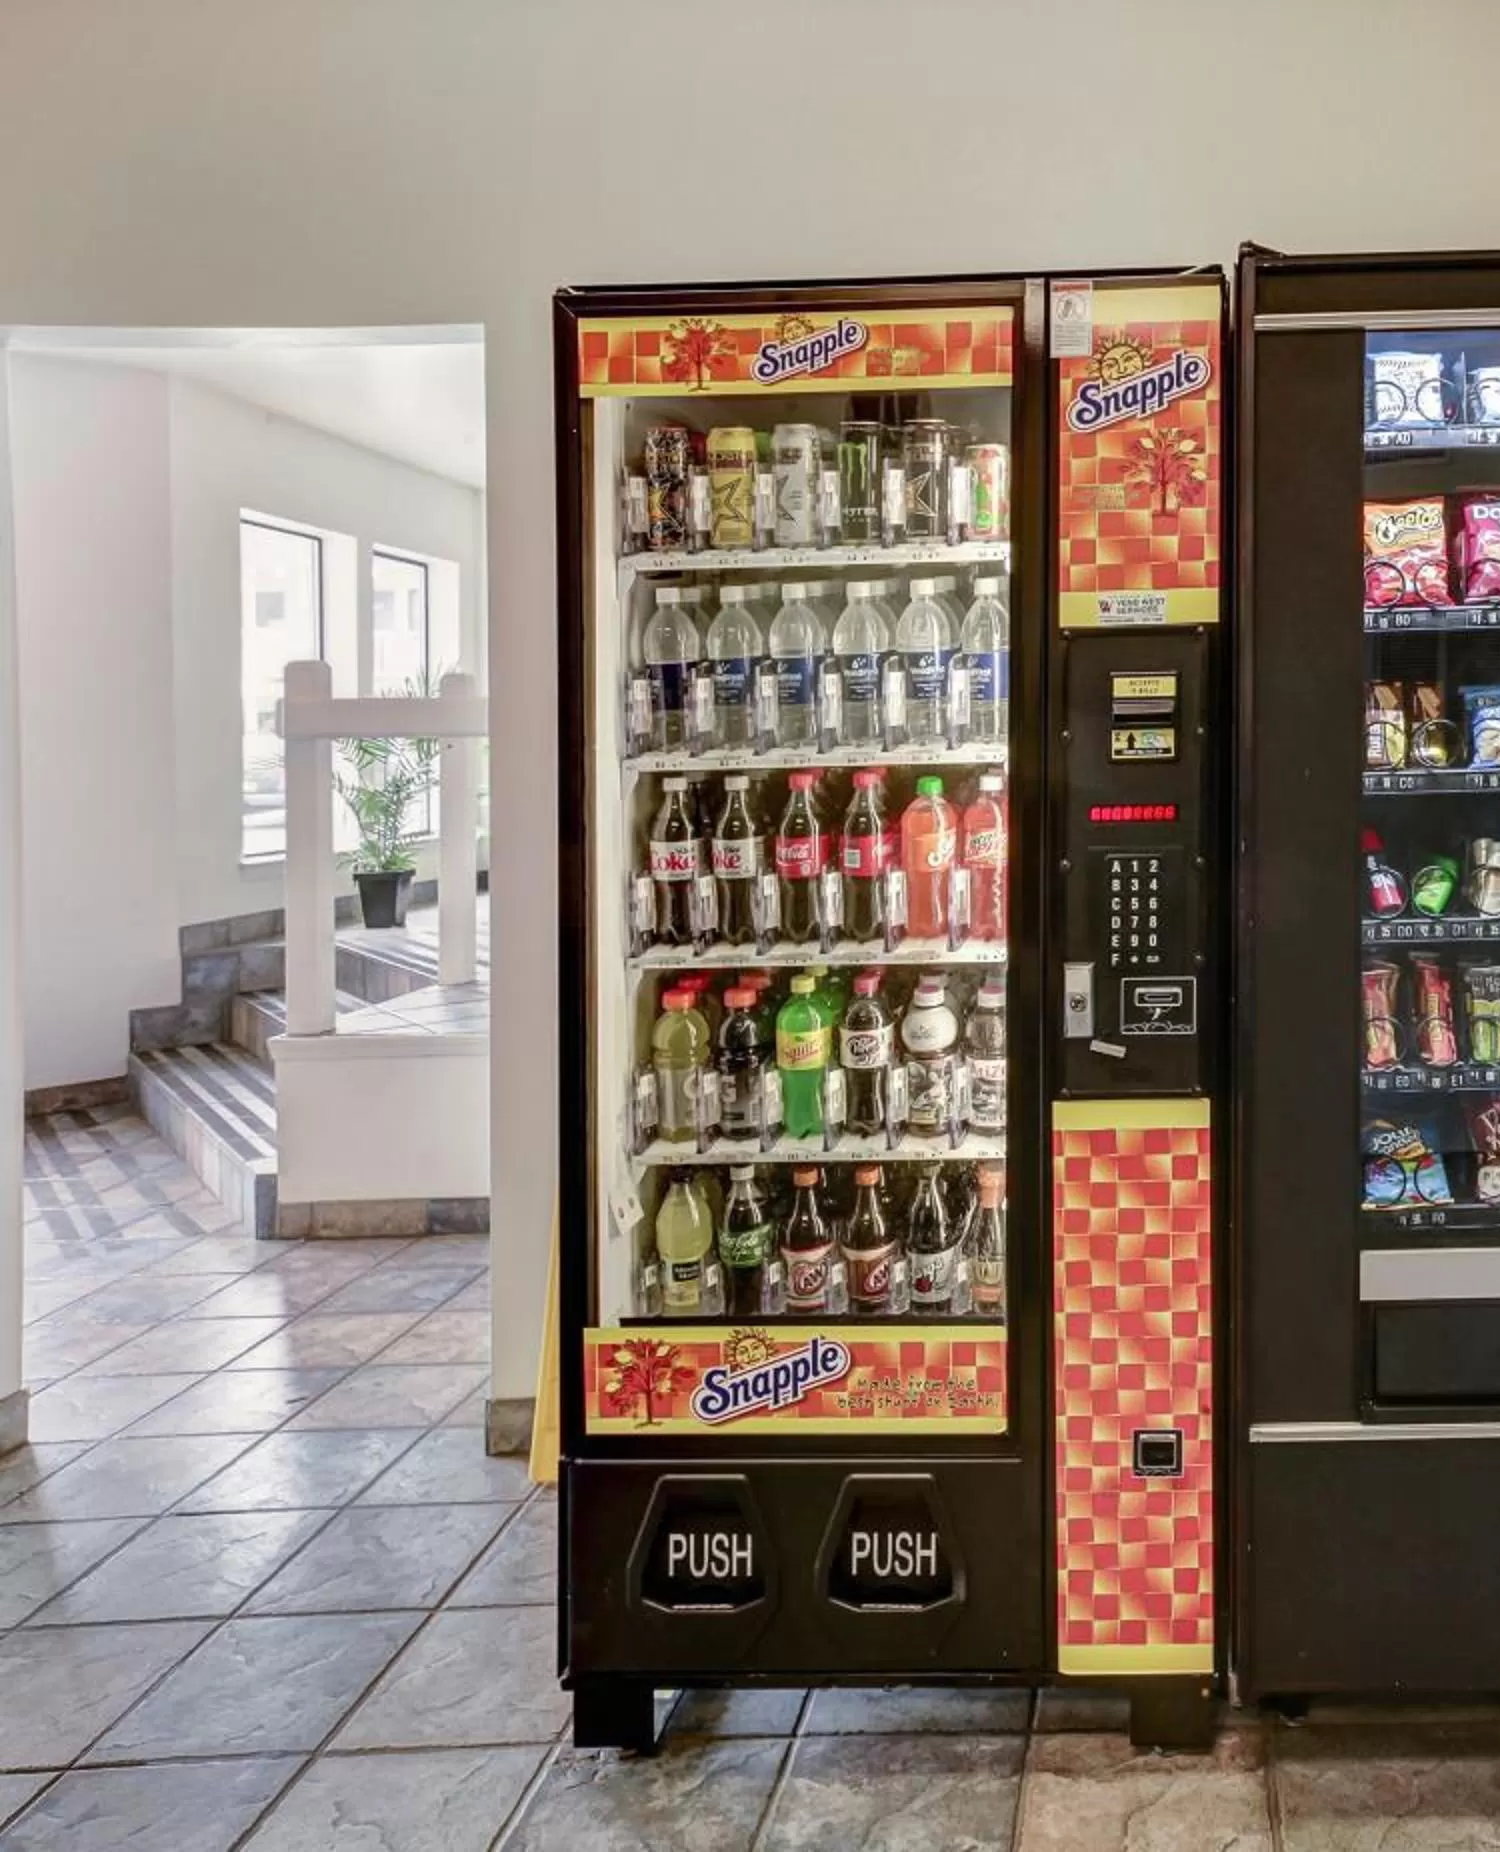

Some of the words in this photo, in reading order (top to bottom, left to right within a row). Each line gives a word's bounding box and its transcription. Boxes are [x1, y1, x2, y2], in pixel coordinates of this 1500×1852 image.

[757, 321, 859, 380] Snapple
[1074, 351, 1201, 425] Snapple
[1376, 506, 1441, 543] Cheetos
[1111, 860, 1122, 874] A
[1130, 860, 1140, 874] 1
[1149, 859, 1159, 873] 2
[1111, 878, 1122, 892] B
[1130, 878, 1140, 892] 3
[1149, 877, 1159, 891] 4
[1111, 897, 1122, 911] C
[1130, 897, 1140, 911] 5
[1149, 896, 1159, 910] 6
[1111, 915, 1122, 929] D
[1130, 915, 1140, 929] 7
[1149, 914, 1159, 928] 8
[1111, 933, 1122, 947] E
[1130, 933, 1140, 947] 9
[1149, 932, 1159, 946] 0
[1111, 953, 1121, 967] F
[699, 1339, 840, 1415] Snapple
[947, 1374, 977, 1391] the
[668, 1533, 753, 1577] PUSH
[851, 1532, 938, 1577] PUSH
